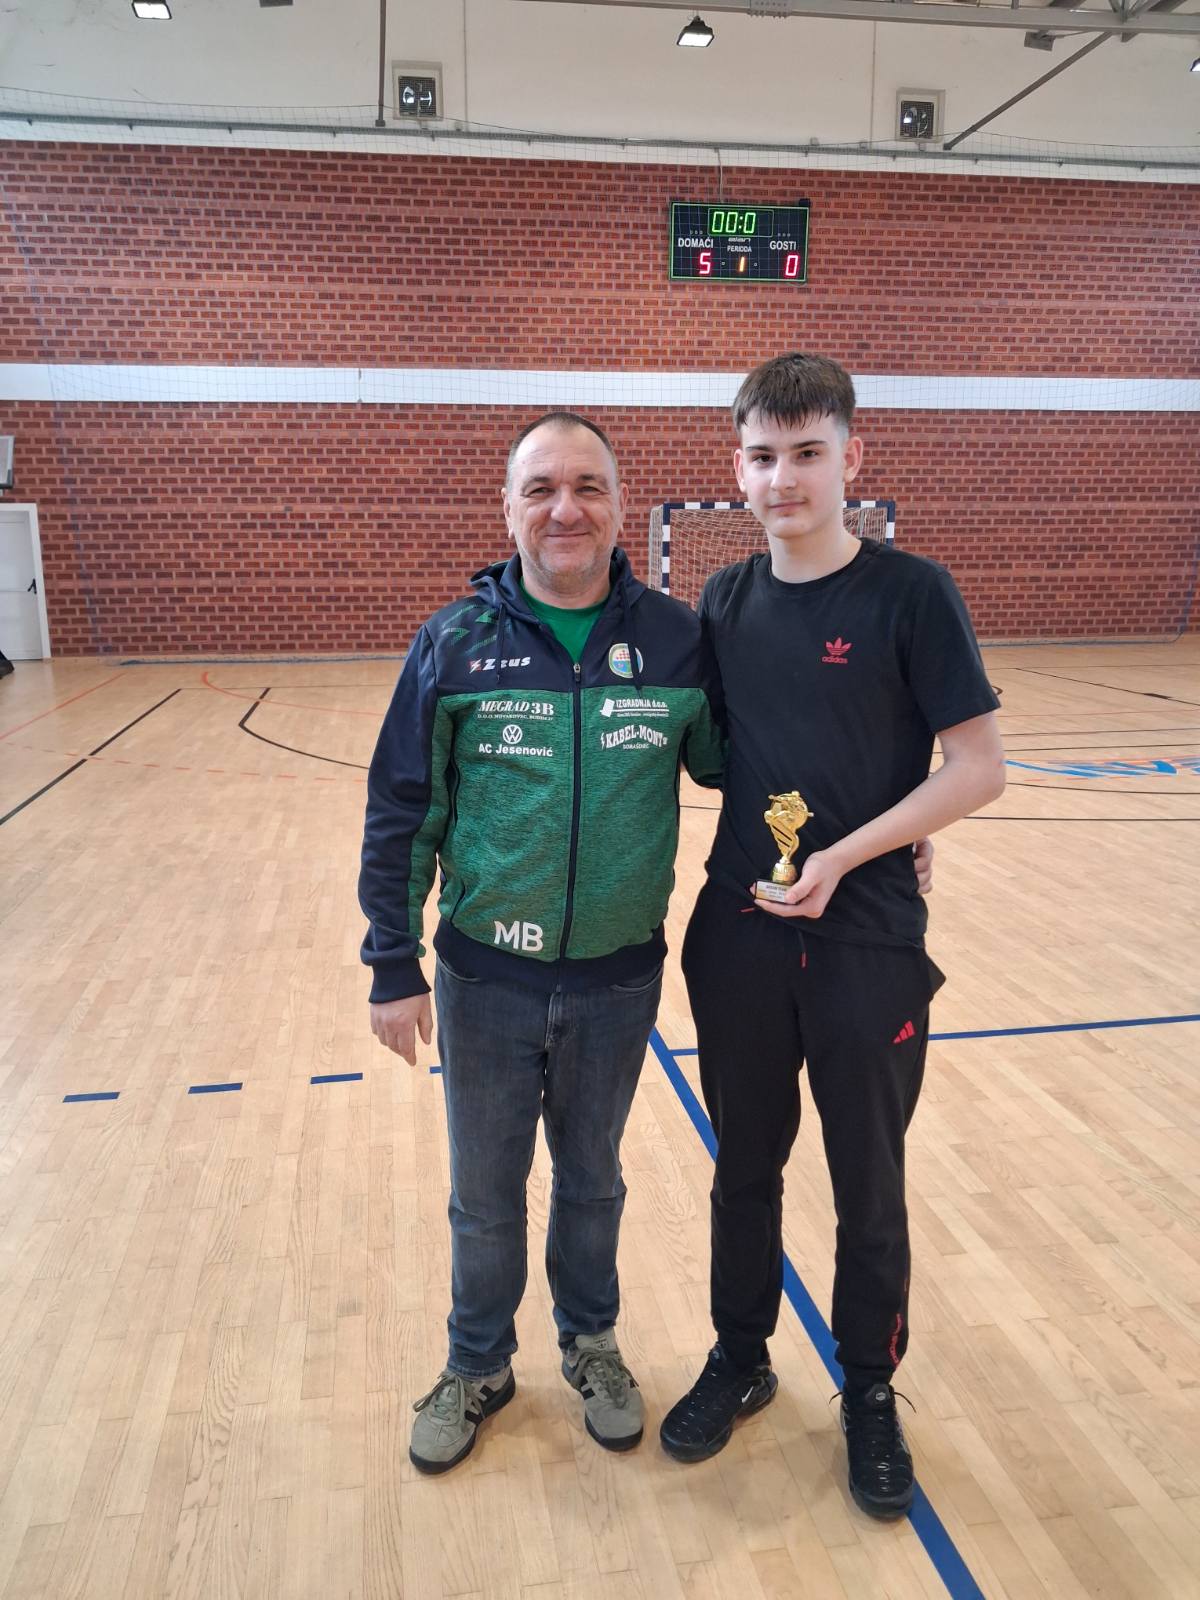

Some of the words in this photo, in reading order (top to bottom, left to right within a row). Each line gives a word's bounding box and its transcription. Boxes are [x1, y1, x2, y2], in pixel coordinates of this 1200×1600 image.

[712, 211, 756, 233] 00:0
[677, 236, 714, 248] DOMAĆI
[769, 240, 797, 250] GOSTI
[699, 252, 711, 274] 5
[739, 256, 745, 272] 1
[785, 255, 798, 276] 0
[478, 700, 530, 712] MEGRAD
[530, 702, 554, 715] 3B
[615, 699, 651, 708] IZGRADNJA
[478, 743, 493, 754] AC
[495, 744, 553, 757] Jesenović
[493, 920, 544, 952] MB
